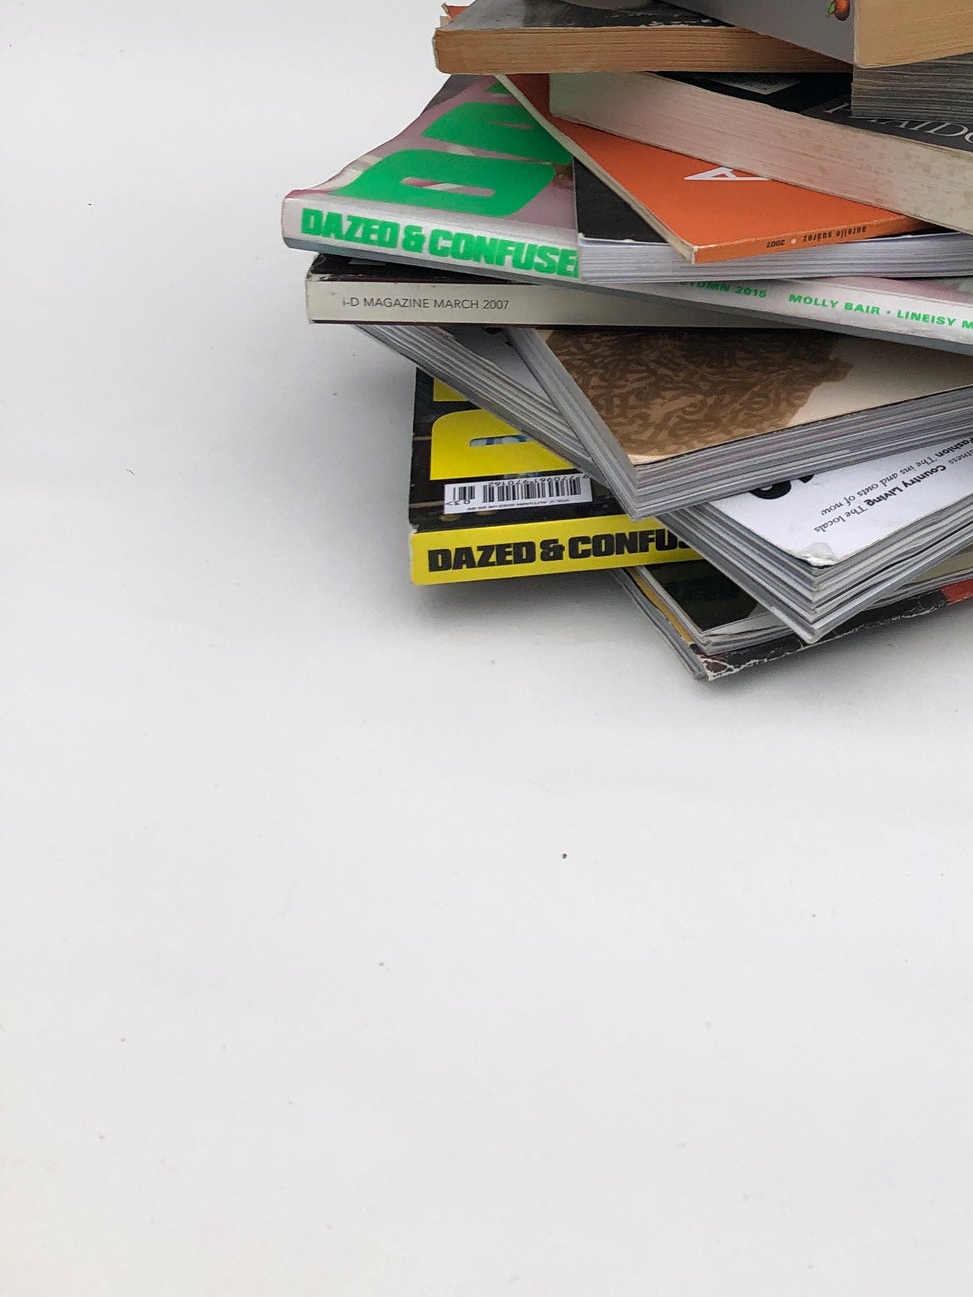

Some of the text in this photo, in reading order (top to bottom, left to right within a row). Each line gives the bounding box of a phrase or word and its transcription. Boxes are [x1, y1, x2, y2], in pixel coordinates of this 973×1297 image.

[301, 207, 579, 279] DAZED & CONFUSE
[766, 239, 786, 248] 2007
[342, 297, 510, 310] i-D MAGAZINE MARCH 2007
[788, 293, 840, 308] MOLLY
[844, 302, 881, 315] BAIR
[896, 309, 957, 327] LINEISY
[915, 456, 938, 467] The
[879, 472, 899, 487] and
[901, 464, 947, 488] Country
[857, 483, 879, 497] outs
[863, 486, 904, 506] Living
[843, 495, 856, 506] of
[821, 501, 844, 516] now
[844, 505, 868, 517] The
[813, 515, 846, 533] locals
[428, 540, 537, 573] DAZED
[540, 538, 565, 563] &
